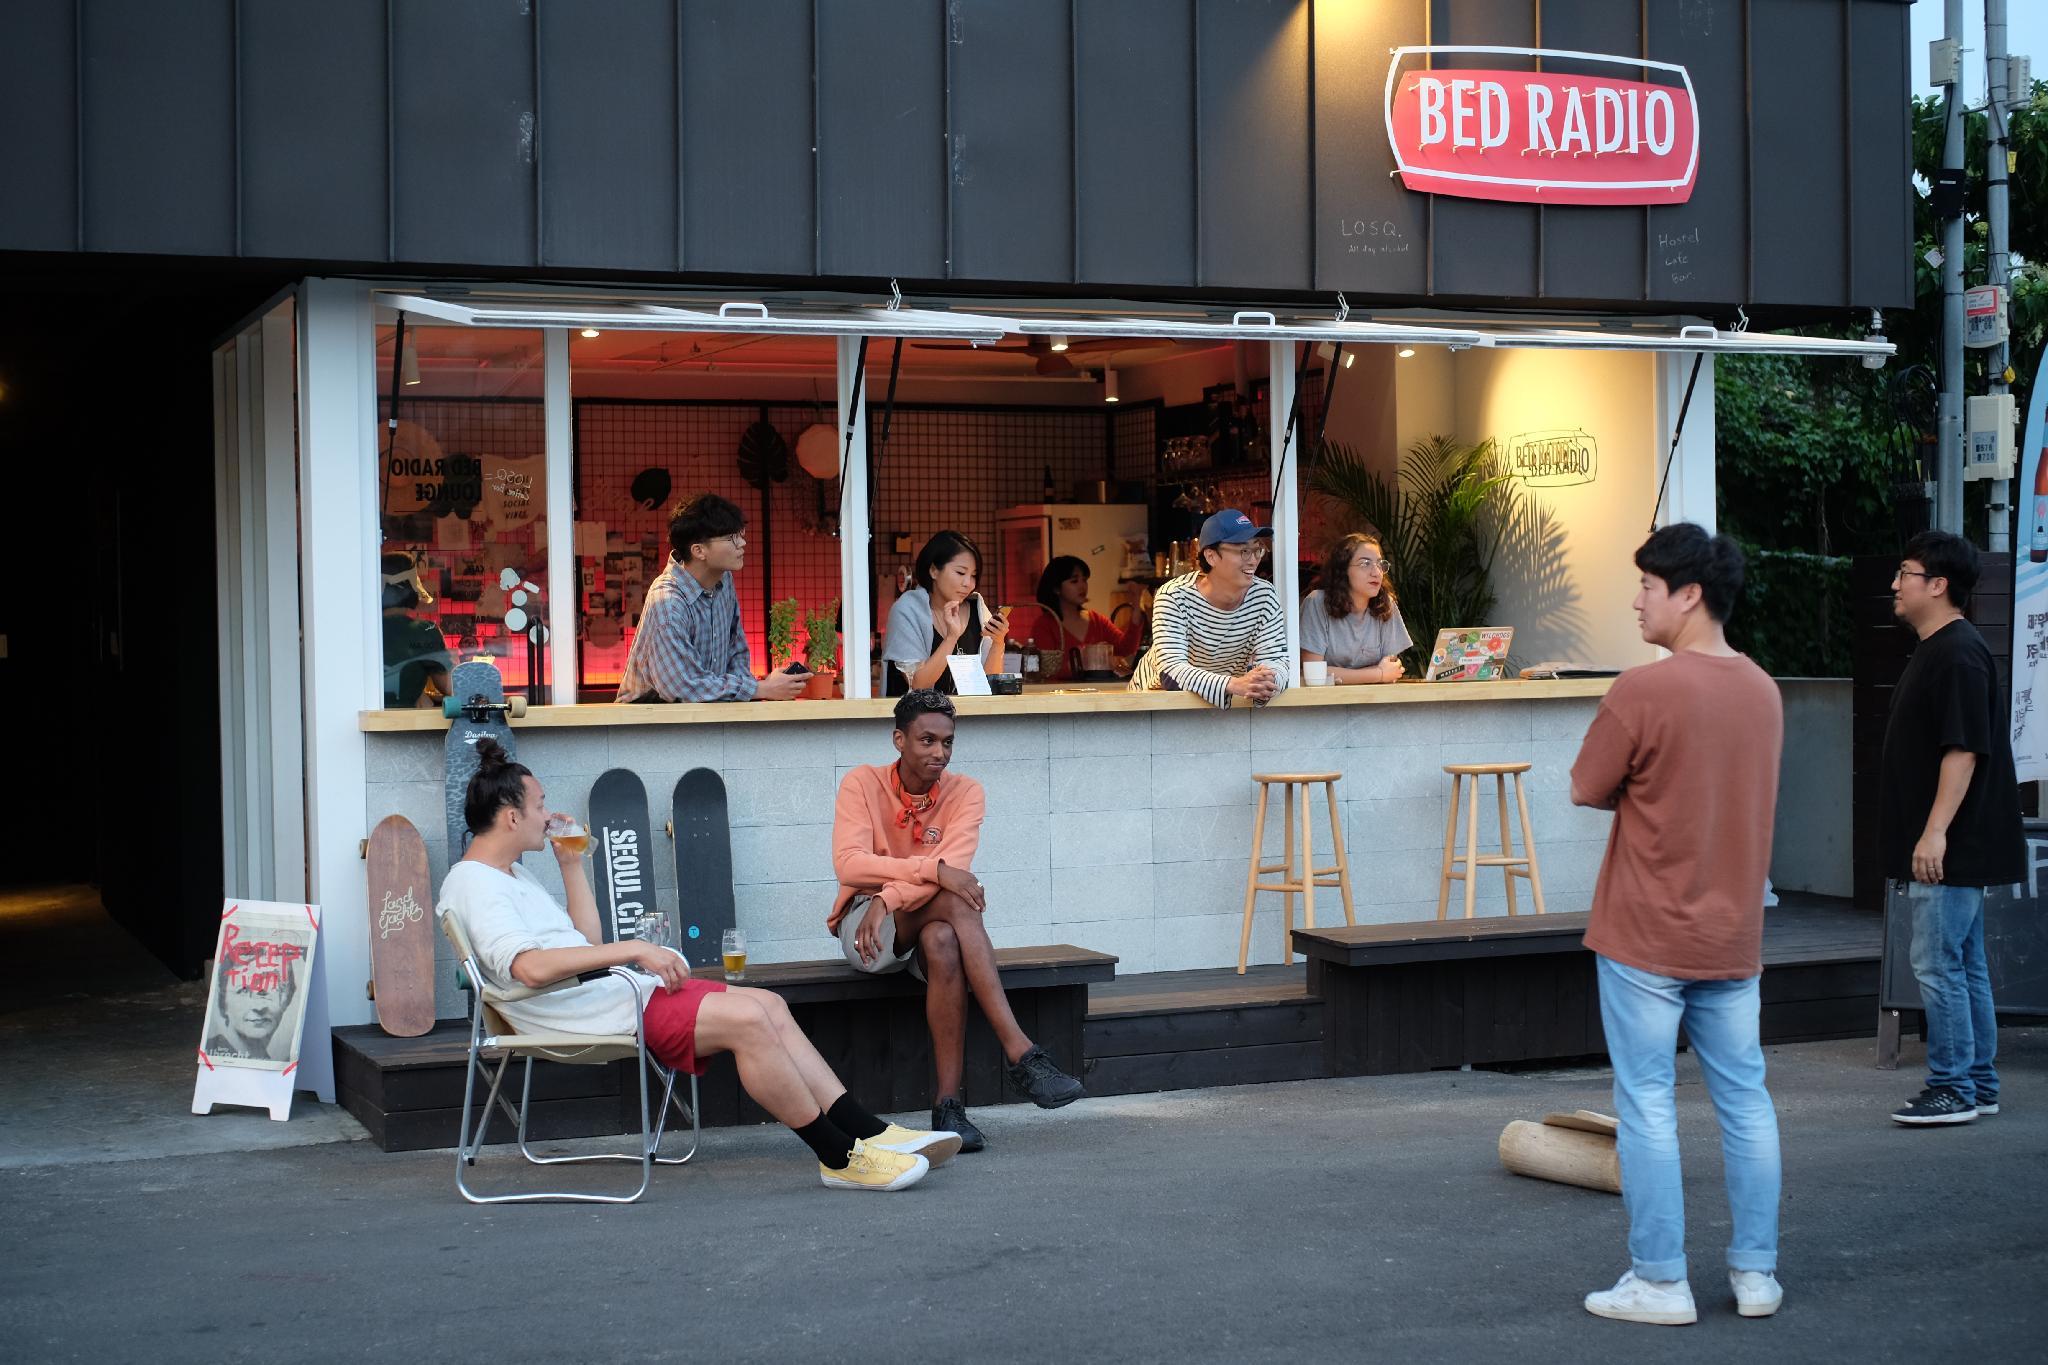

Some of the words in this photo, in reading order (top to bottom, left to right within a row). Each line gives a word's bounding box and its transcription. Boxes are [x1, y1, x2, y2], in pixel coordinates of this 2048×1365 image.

[1419, 76, 1511, 148] BED
[1527, 83, 1675, 157] RADIO
[610, 829, 642, 899] SEOUL
[380, 886, 414, 916] Land
